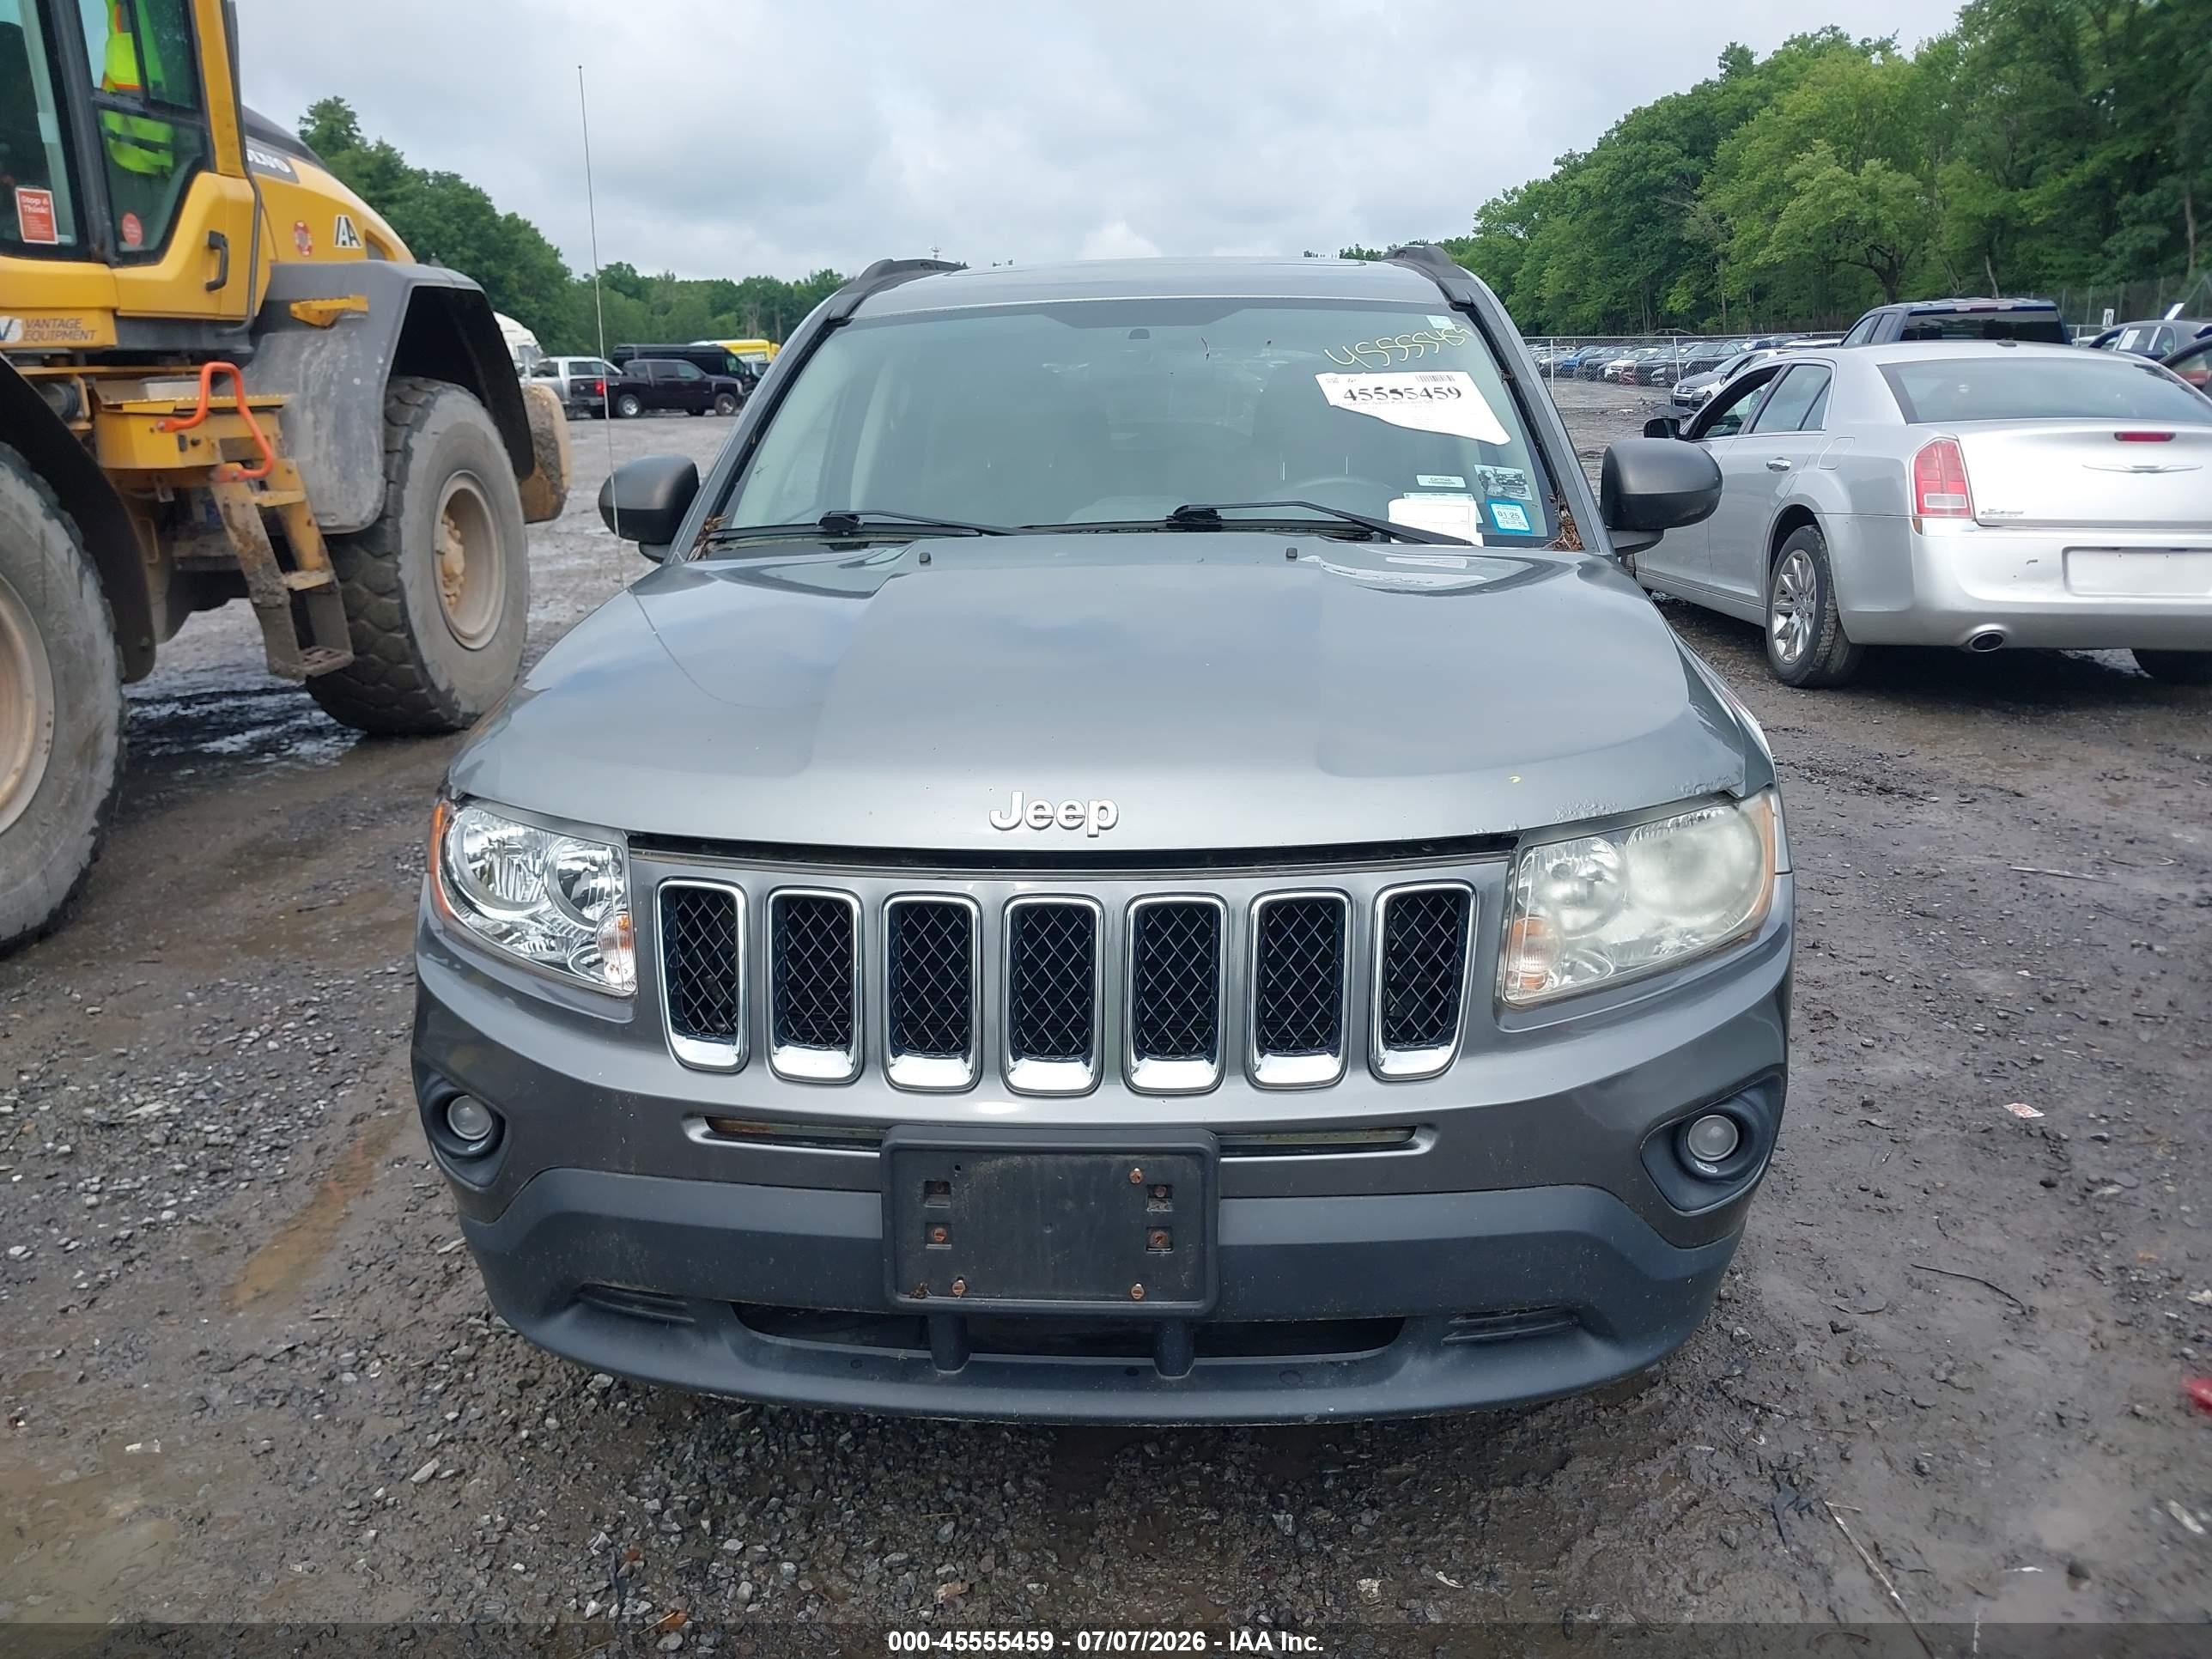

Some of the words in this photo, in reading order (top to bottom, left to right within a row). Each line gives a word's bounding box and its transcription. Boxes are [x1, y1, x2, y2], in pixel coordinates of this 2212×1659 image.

[26, 318, 82, 329] VANTAGE
[24, 329, 98, 342] EQUIPMENT
[1343, 386, 1462, 401] 45555459
[988, 790, 1120, 838] Jeep
